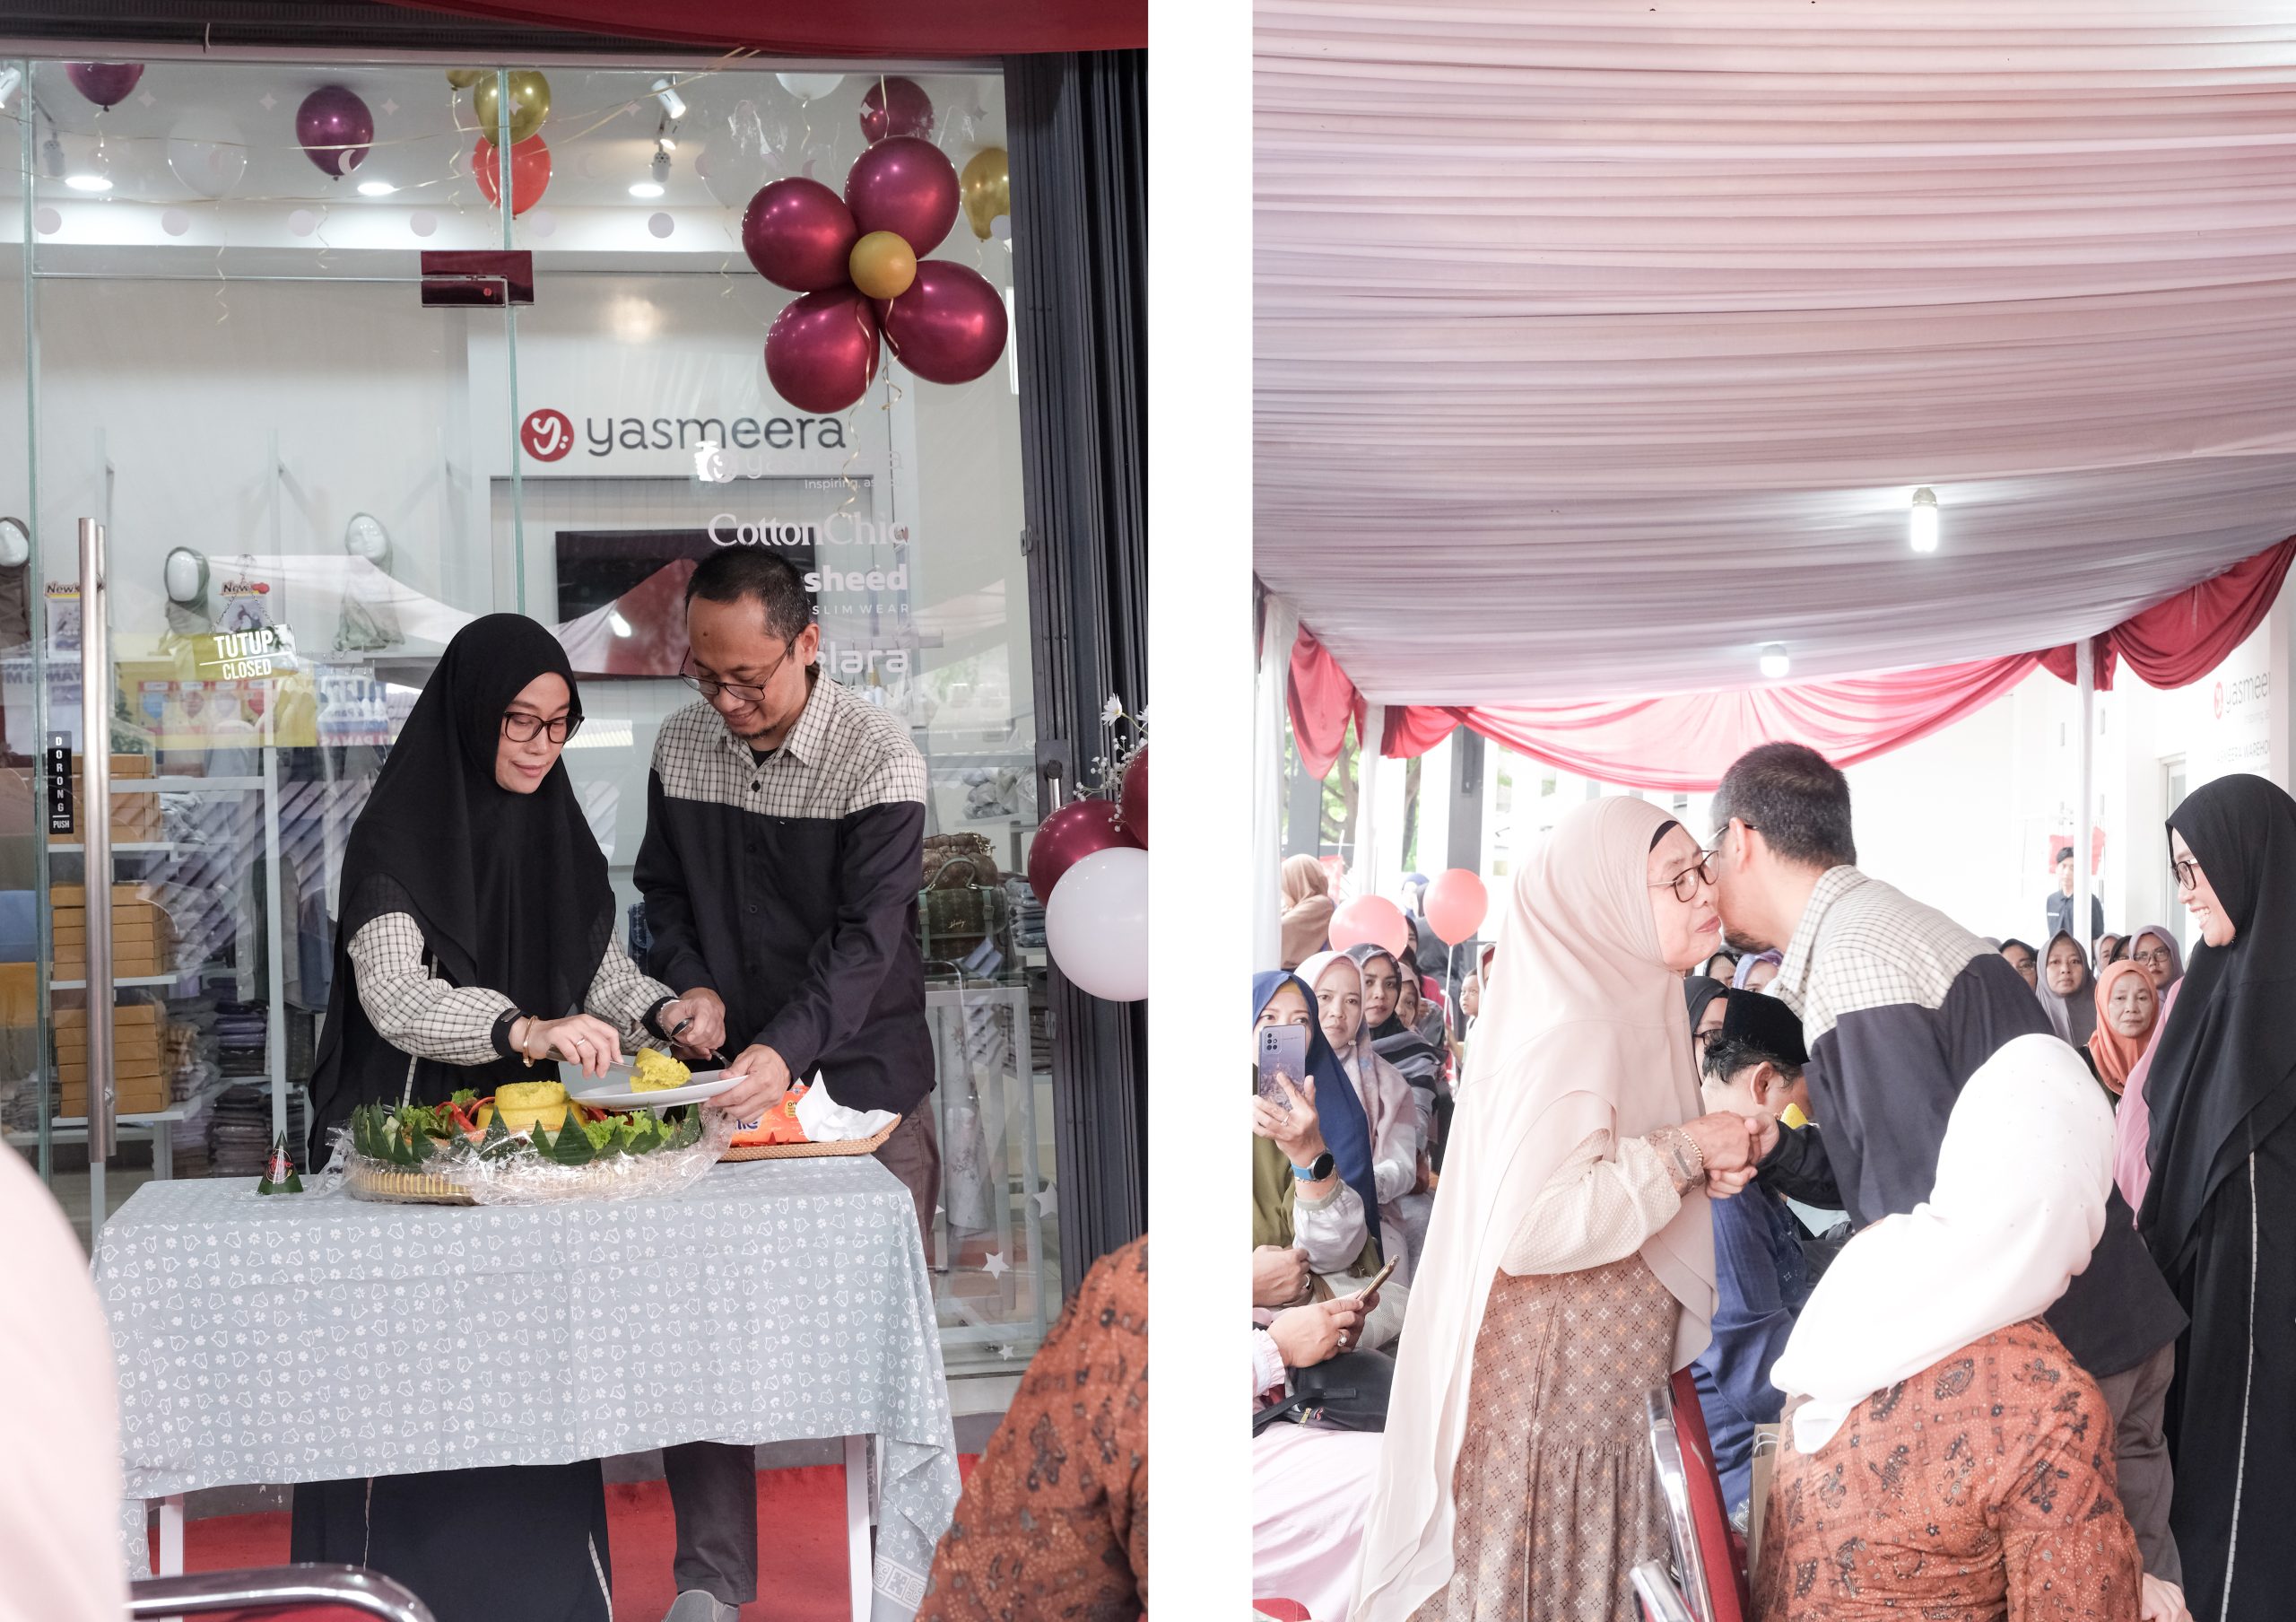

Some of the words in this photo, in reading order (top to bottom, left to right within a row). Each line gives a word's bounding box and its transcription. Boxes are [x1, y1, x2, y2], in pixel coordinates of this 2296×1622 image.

[587, 417, 846, 457] yasmeera
[708, 512, 909, 546] CottonChic
[859, 604, 909, 615] WEAR
[213, 630, 274, 659] TUTUP
[222, 658, 272, 681] CLOSED
[55, 736, 65, 813] DORONG
[53, 820, 70, 829] PUSH
